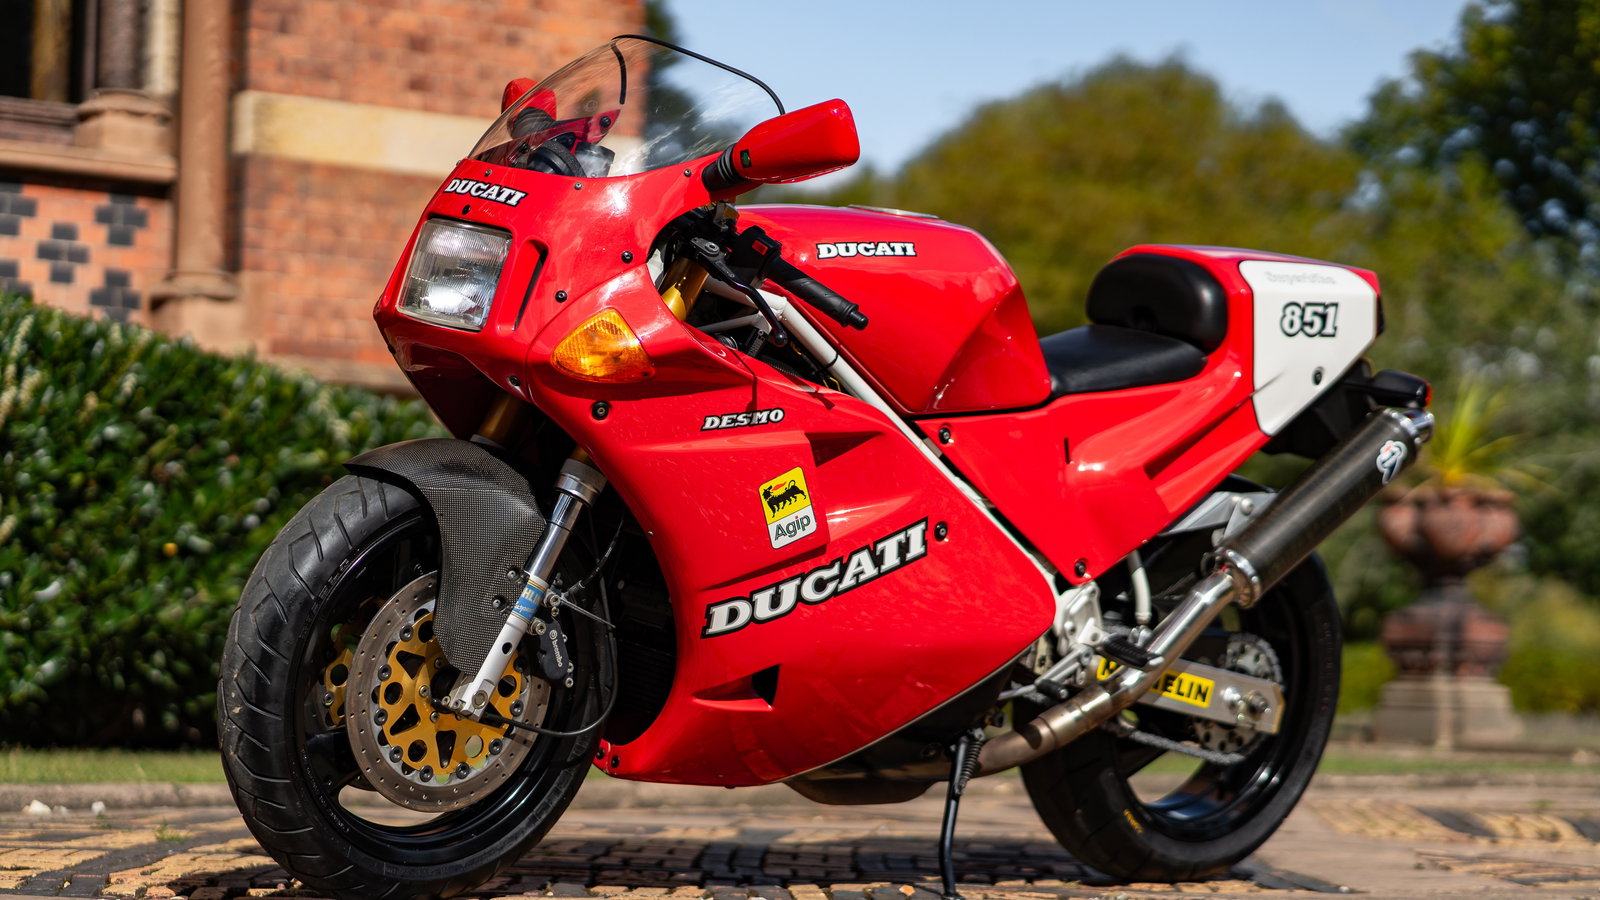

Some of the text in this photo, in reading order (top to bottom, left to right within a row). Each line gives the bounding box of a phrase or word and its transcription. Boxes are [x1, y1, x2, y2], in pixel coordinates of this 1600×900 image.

[443, 178, 528, 207] DUCATI
[817, 242, 917, 259] DUCATI
[1280, 301, 1338, 337] 851
[701, 408, 785, 431] DESMO
[774, 515, 811, 541] Agip
[701, 518, 928, 638] DUCATI
[552, 639, 563, 667] brembo
[1101, 659, 1209, 702] MELIN
